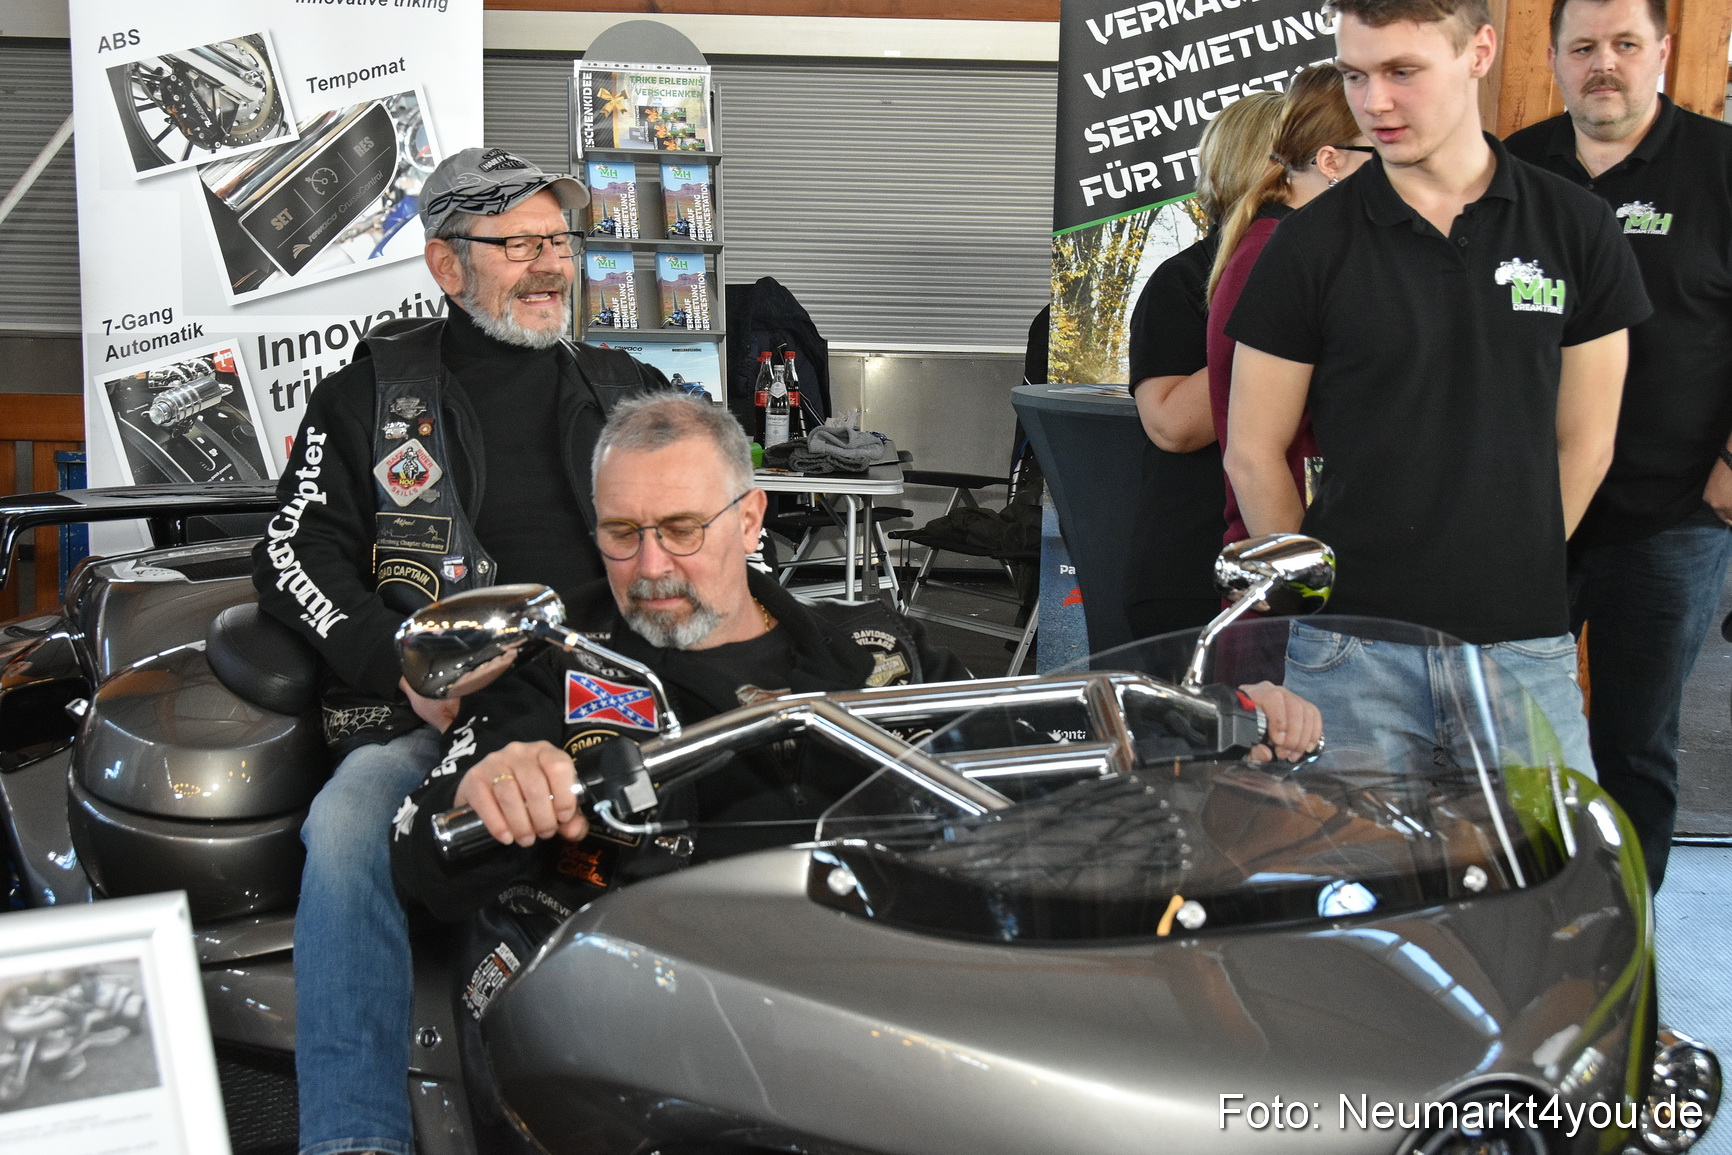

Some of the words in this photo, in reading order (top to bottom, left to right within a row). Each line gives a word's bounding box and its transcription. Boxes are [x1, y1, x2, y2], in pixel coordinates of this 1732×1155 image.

[1085, 0, 1260, 46] VERKAU
[98, 28, 142, 54] ABS
[1083, 8, 1337, 99] VERMIETUNG
[306, 56, 406, 94] Tempomat
[630, 75, 657, 84] TRIKE
[659, 77, 704, 86] ERLEBNIS
[634, 88, 704, 98] VERSCHENKEN
[582, 72, 595, 148] SCHENKIDEE
[353, 136, 375, 158] RES
[339, 170, 384, 213] CruiseControl
[1079, 160, 1162, 207] FÜR
[270, 208, 294, 231] SET
[613, 206, 623, 239] ERKAUF
[620, 193, 630, 239] ERMIETUNG
[627, 180, 639, 239] ERVICESTATION
[1623, 212, 1673, 231] MH
[619, 283, 629, 329] ERMIETUNG
[625, 269, 638, 329] ERVICESTATION
[691, 284, 702, 330] ERMIETUNG
[697, 271, 710, 330] ERVICESTATION
[1511, 277, 1566, 307] MH
[102, 307, 174, 336] 7-Gang
[612, 297, 621, 329] ERKAUF
[684, 298, 694, 330] ERKAUF
[105, 322, 205, 363] Automatik
[417, 448, 434, 468] RIDER
[391, 487, 419, 497] SKILLS
[393, 565, 431, 586] CAPTAIN
